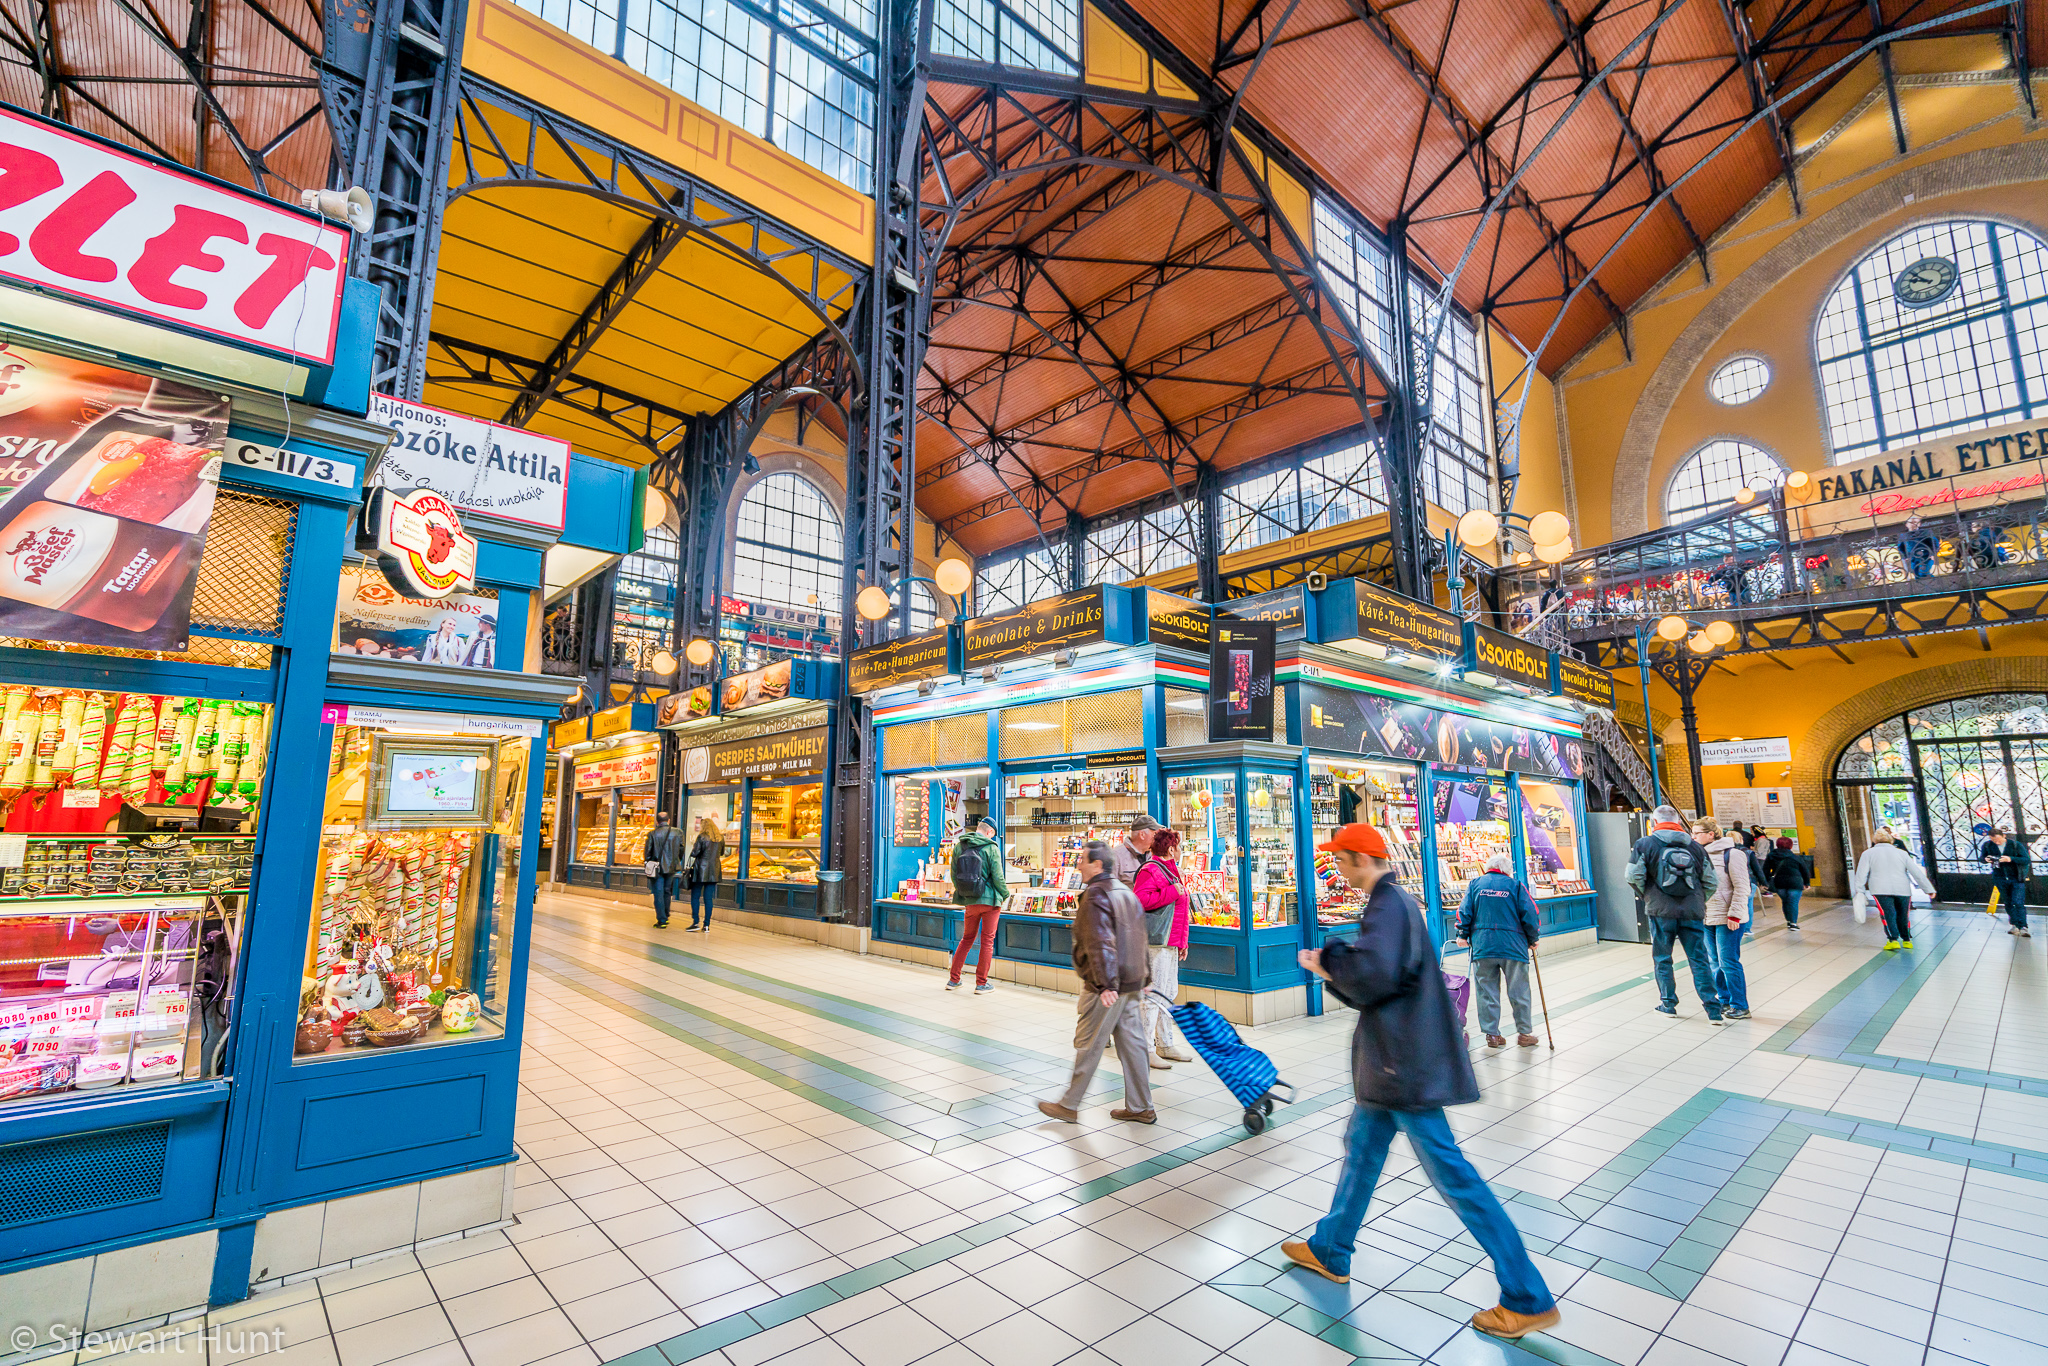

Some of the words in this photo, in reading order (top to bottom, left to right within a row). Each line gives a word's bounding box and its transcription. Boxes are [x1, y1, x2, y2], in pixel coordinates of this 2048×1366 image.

[238, 444, 340, 483] C-II/3.
[389, 419, 477, 464] Szőke
[487, 443, 562, 485] Attila
[1818, 450, 1943, 501] FAKANÁL
[498, 485, 545, 507] unokája
[415, 498, 462, 535] KABANOS
[24, 526, 65, 569] Beef
[24, 528, 76, 586] Master
[102, 547, 150, 594] Tatar
[352, 608, 396, 623] Najlepsze
[967, 623, 1031, 652] Chocolate
[1036, 618, 1046, 633] &
[1052, 606, 1103, 632] Drinks
[1559, 667, 1589, 689] Chocolate
[1588, 678, 1594, 690] &
[1594, 681, 1613, 696] Drinks
[468, 718, 523, 732] hungarikum
[714, 748, 755, 768] CSERPES
[756, 735, 825, 762] SAJTMŰHELY
[1702, 745, 1768, 757] hungarikum
[721, 767, 742, 777] BAKERY
[745, 764, 760, 774] CAKE
[761, 762, 777, 772] SHOP
[782, 759, 797, 770] MILK
[799, 758, 812, 769] BAR
[65, 1005, 91, 1016] 1910
[115, 1009, 135, 1018] 565
[166, 1004, 185, 1014] 750
[31, 1041, 59, 1052] 7090
